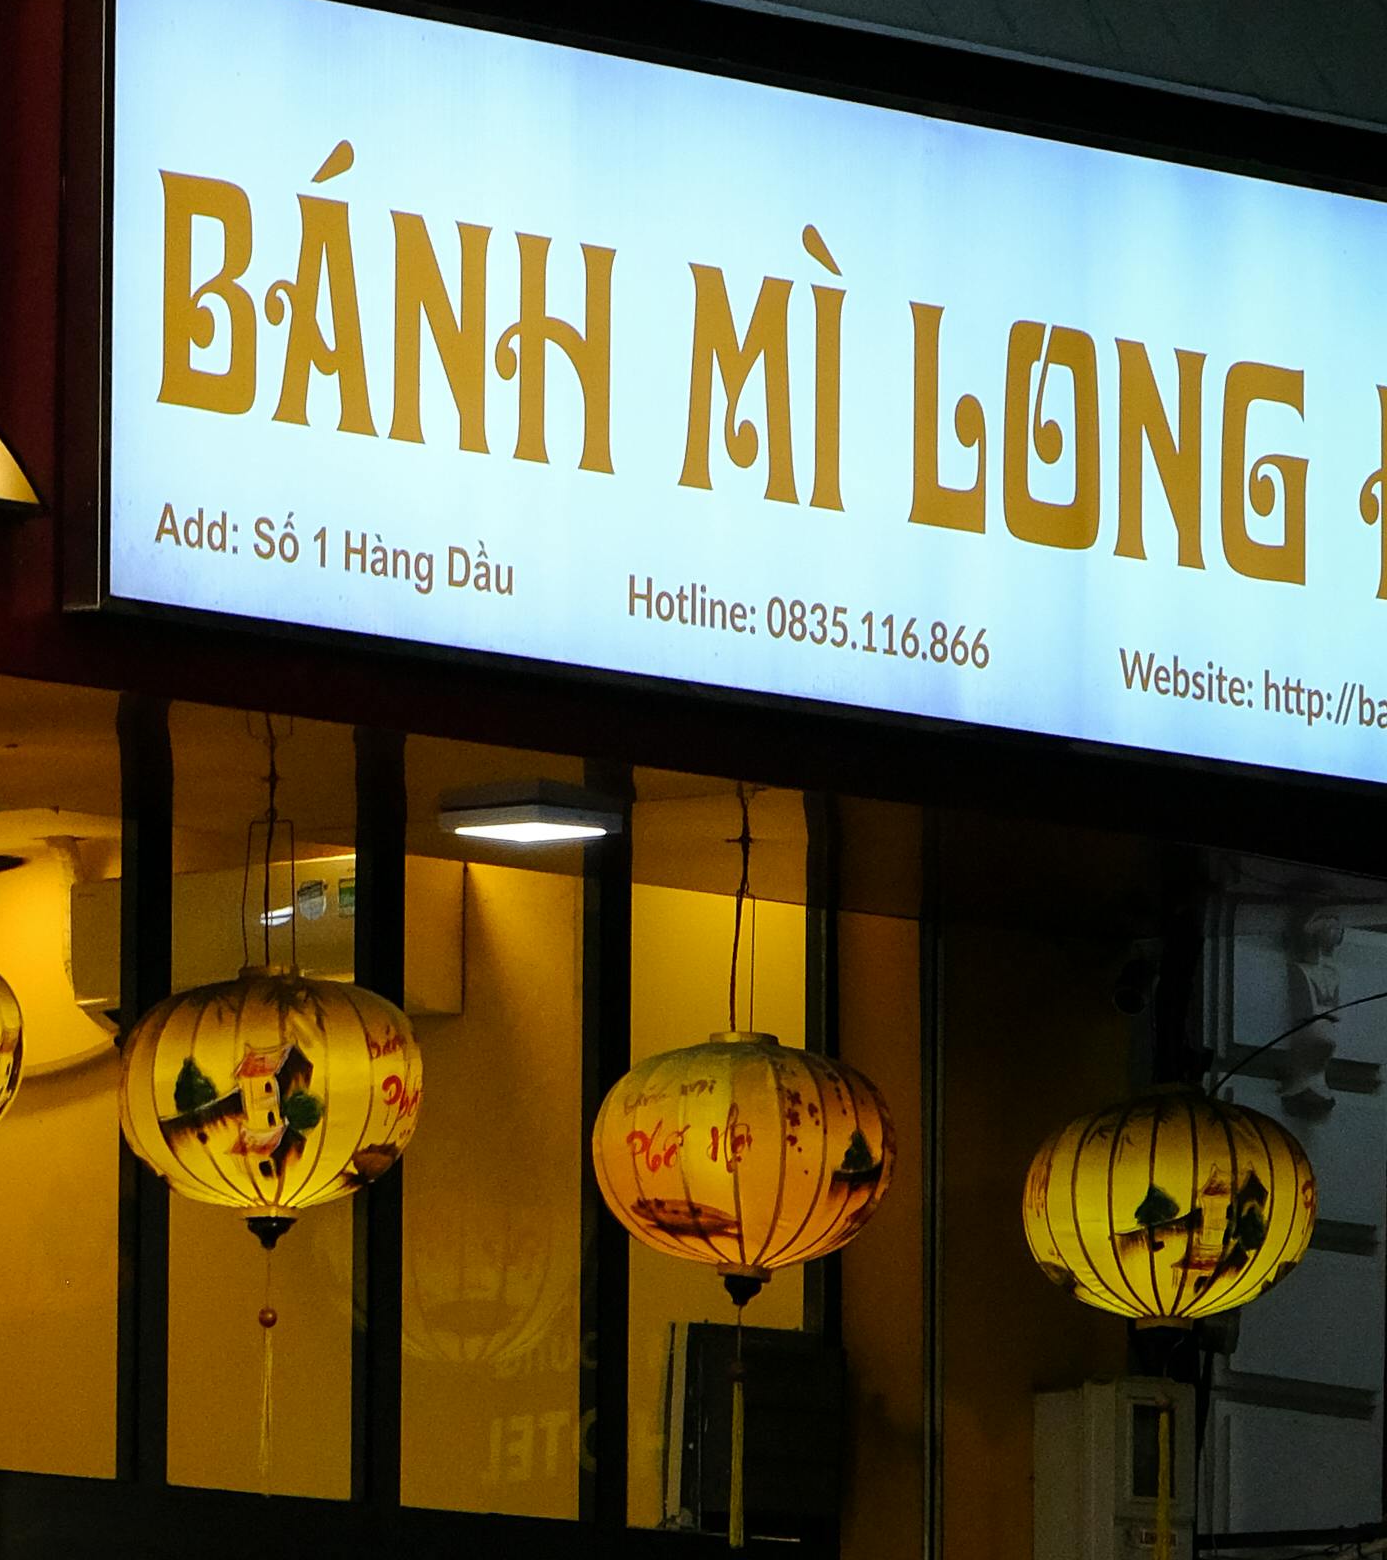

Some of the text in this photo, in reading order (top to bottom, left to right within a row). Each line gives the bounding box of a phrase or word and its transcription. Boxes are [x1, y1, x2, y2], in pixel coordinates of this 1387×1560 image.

[157, 140, 617, 474] BÁNH
[678, 224, 847, 512] MÌ
[908, 300, 1310, 586] LONG
[154, 502, 515, 597] Add: Số 1 Hàng Dầu
[628, 574, 990, 669] Hotline: 0835.116.866
[1120, 647, 1254, 709] Website:
